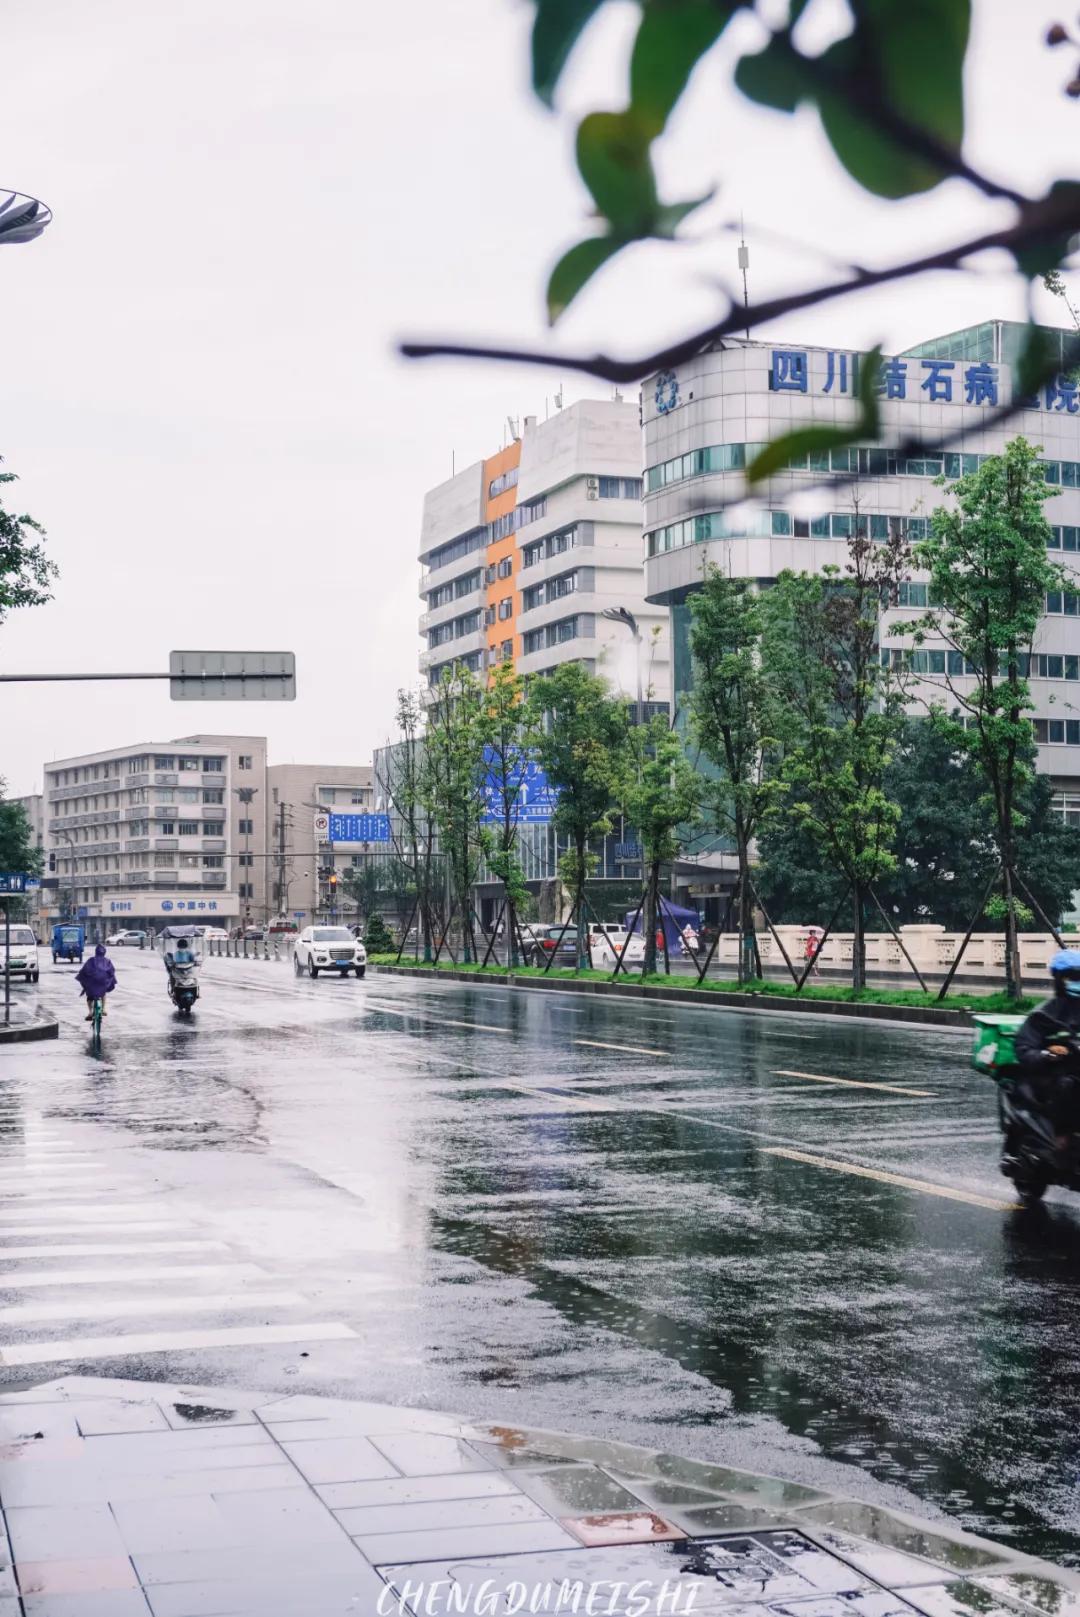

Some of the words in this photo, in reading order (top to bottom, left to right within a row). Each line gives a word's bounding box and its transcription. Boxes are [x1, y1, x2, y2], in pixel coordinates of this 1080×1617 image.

[772, 350, 1080, 414] 四川结石病院
